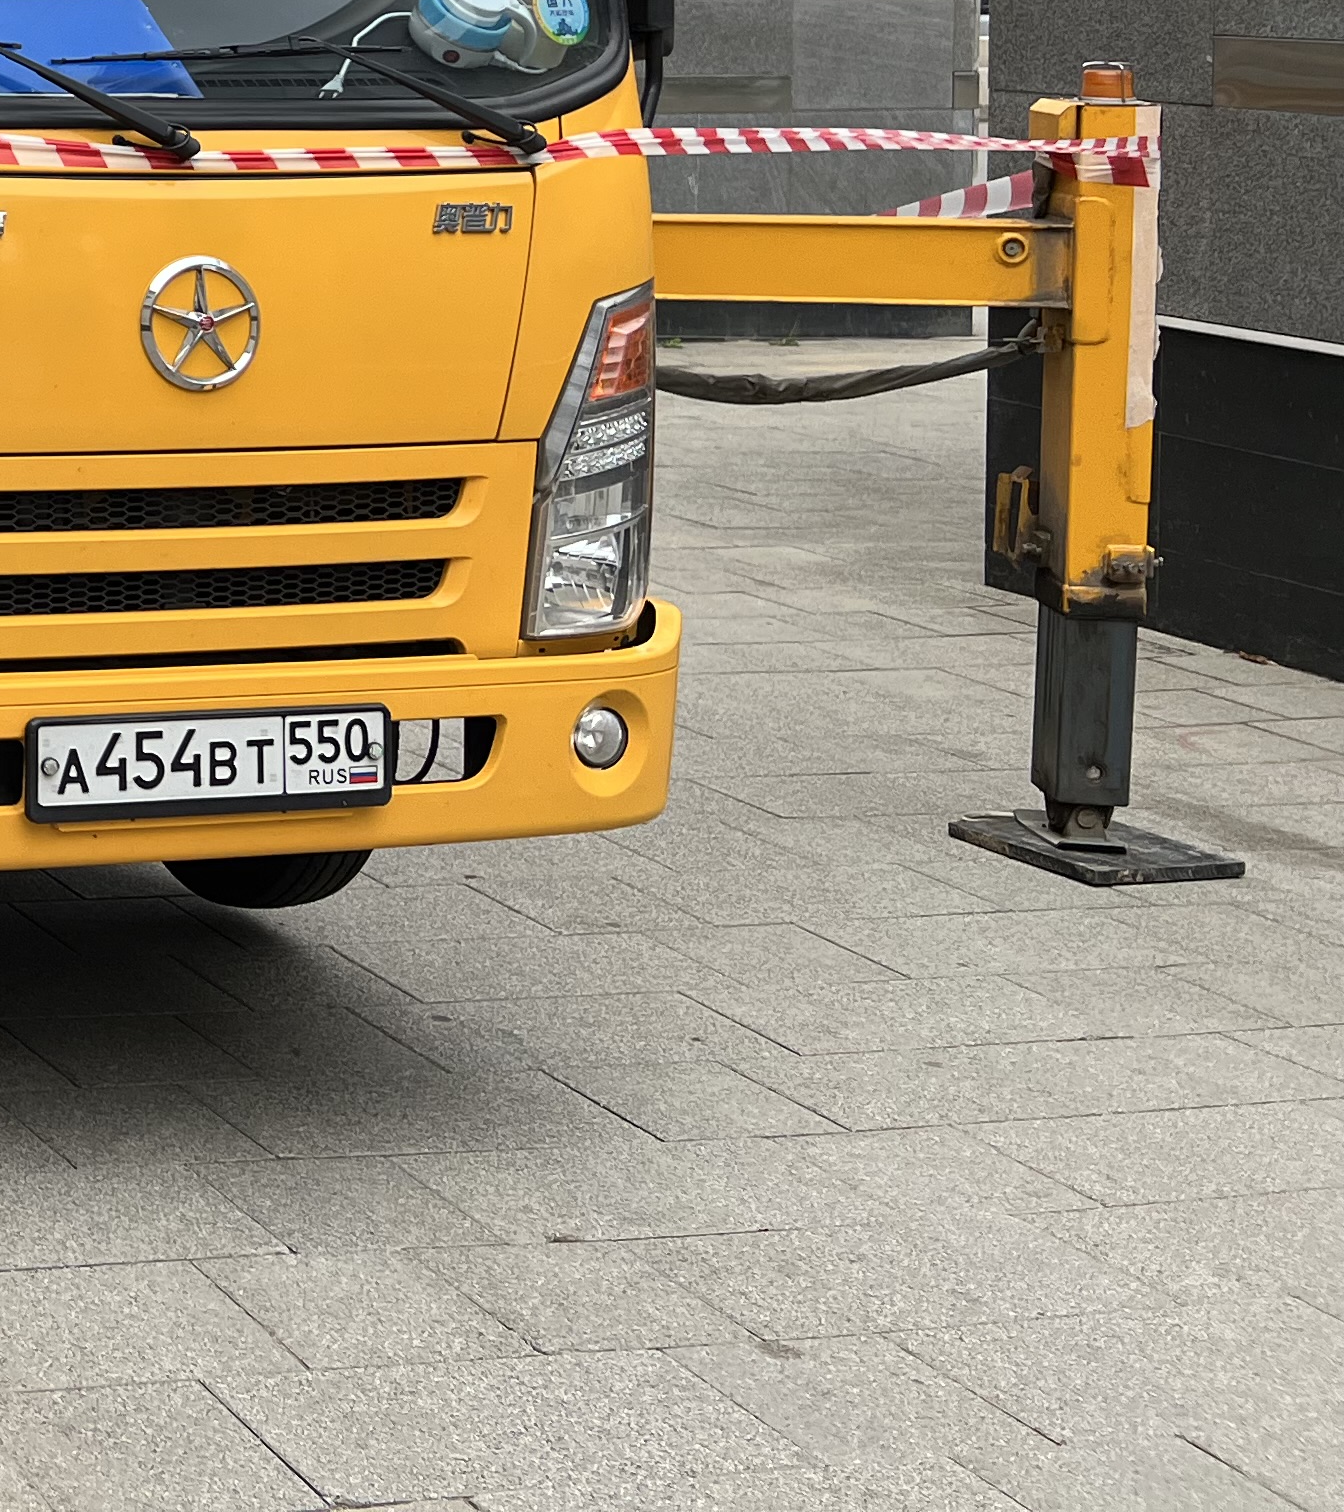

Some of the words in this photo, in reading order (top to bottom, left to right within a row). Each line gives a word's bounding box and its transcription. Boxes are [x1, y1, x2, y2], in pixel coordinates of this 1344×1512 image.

[432, 202, 514, 234] 奥普力
[56, 728, 275, 795] А454ВТ
[288, 718, 370, 765] 550
[308, 768, 348, 786] RUS
